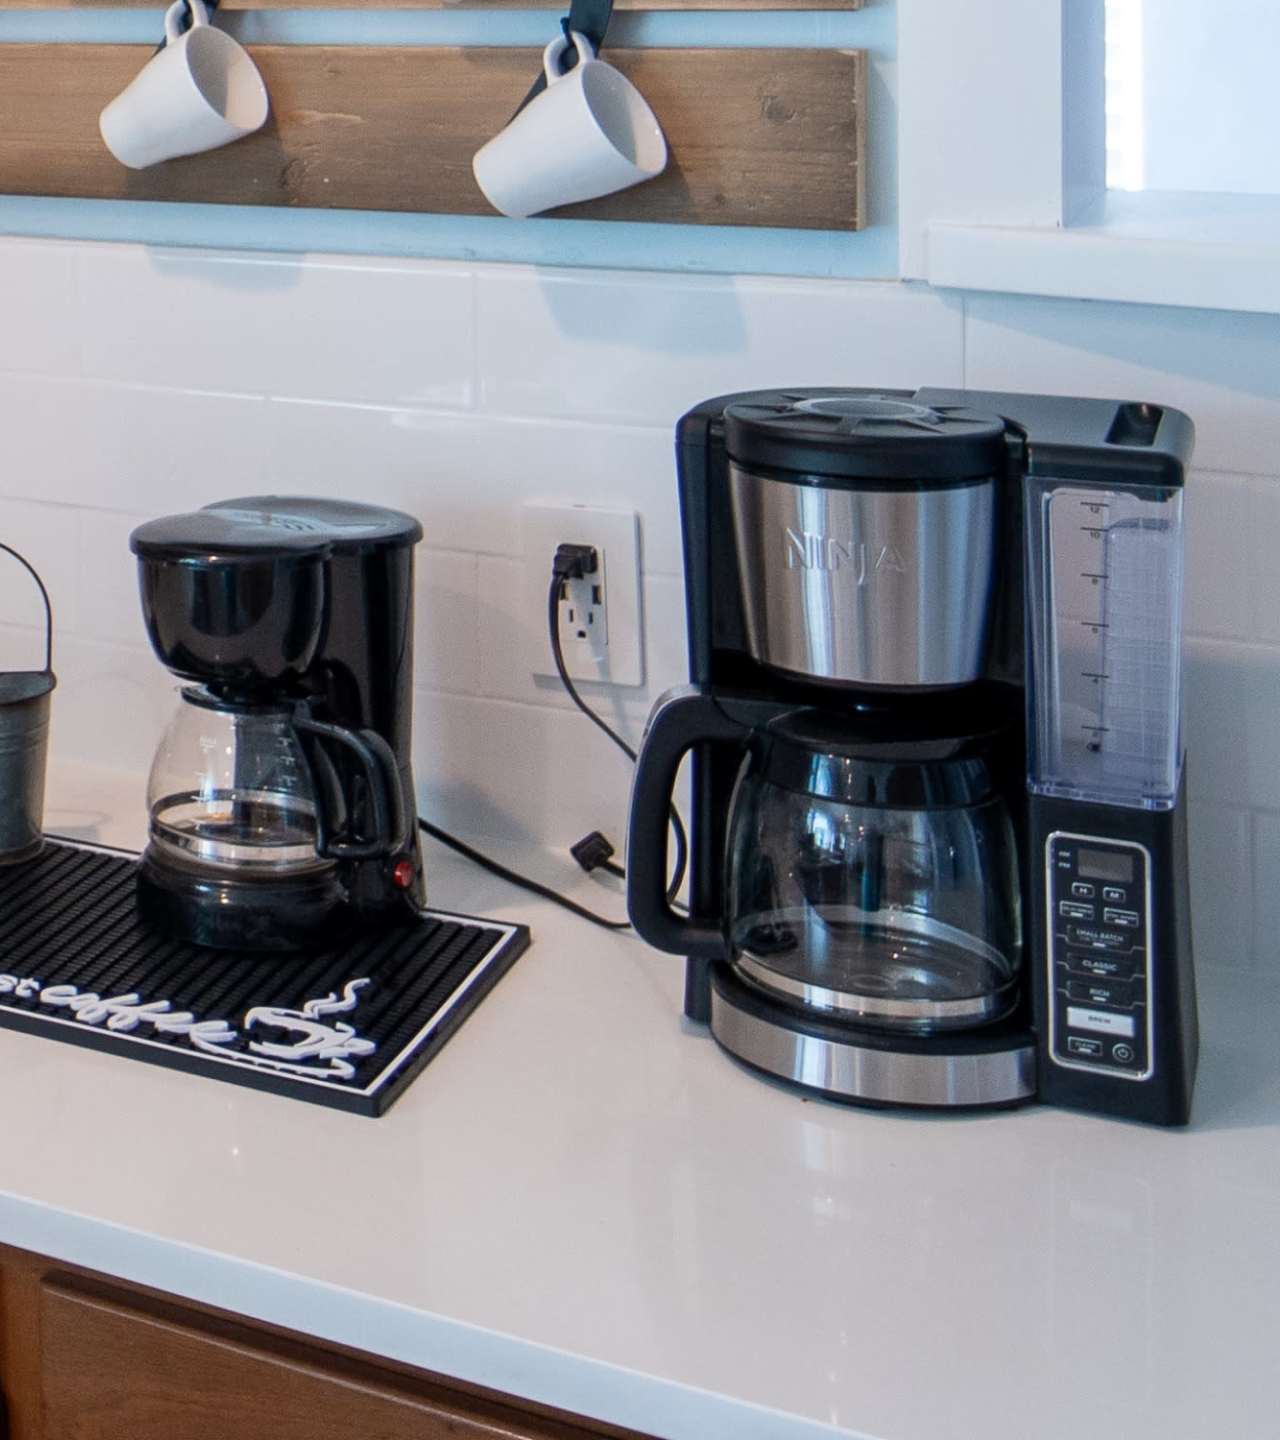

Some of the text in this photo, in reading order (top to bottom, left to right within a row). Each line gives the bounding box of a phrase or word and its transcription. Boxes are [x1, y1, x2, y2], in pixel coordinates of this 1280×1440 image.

[785, 527, 907, 586] NINJA
[1082, 960, 1118, 971] CLASSIC
[40, 984, 239, 1045] coffee
